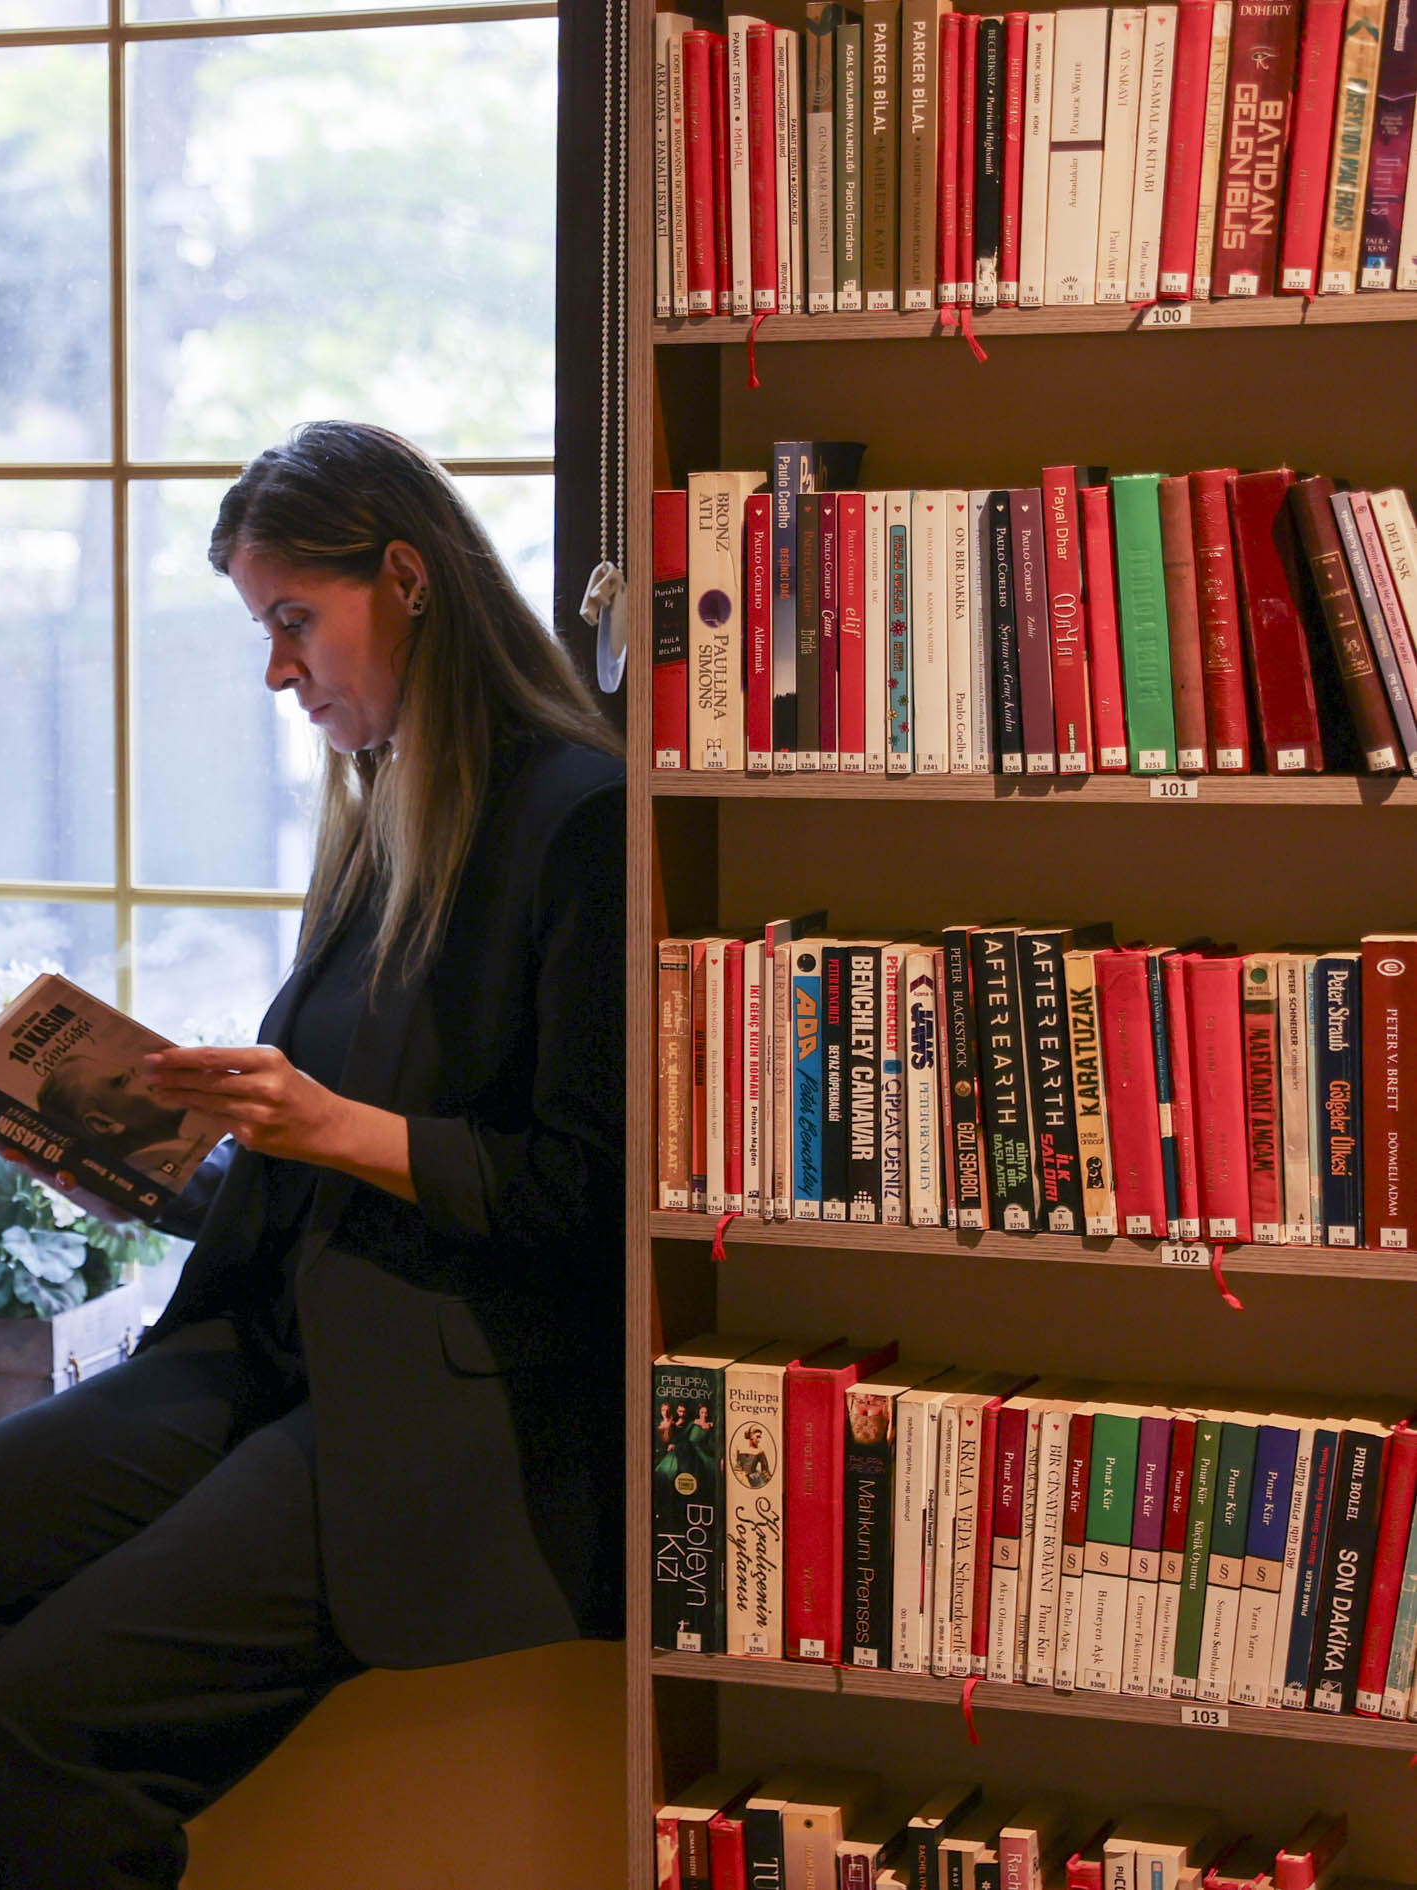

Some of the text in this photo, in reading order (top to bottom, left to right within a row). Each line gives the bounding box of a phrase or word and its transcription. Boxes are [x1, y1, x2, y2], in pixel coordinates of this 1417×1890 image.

[1240, 5, 1291, 16] DOHERTY
[732, 32, 741, 68] PANAIT
[873, 23, 889, 136] PARKER BİLAL
[912, 20, 928, 134] PARKER BİLAL
[656, 62, 666, 121] ARKADAŞ
[733, 72, 742, 110] ISTRATI
[845, 44, 856, 173] ASAL SAYILARIN YALNIZLIĞI
[983, 96, 995, 175] Patricia Highsmith
[1229, 83, 1283, 235] BATIDAN GELEN
[844, 181, 855, 261] Paolo Giordano
[1153, 309, 1182, 324] 100
[698, 492, 730, 553] BRONZ ATLI
[777, 455, 791, 529] Paulo Coelho
[1051, 486, 1071, 561] Payal Dhar
[754, 531, 765, 674] PAULO COELHO Aldatmak
[821, 532, 835, 637] PAULO COELHO Casus
[1021, 529, 1034, 603] PAULO COELHO
[1394, 556, 1411, 581] AŞK
[841, 607, 861, 638] elif
[954, 527, 967, 720] ON BİR DAKİKA Paulo
[996, 527, 1016, 733] PAULO COELHO Şeytan Genç Kadın
[698, 634, 729, 721] PAULLINA SIMONS
[1159, 782, 1188, 796] 101
[950, 947, 962, 983] PETER
[8, 1042, 37, 1065] 10
[23, 1003, 77, 1048] KASIM
[828, 958, 841, 1122] PETER BENCHLEY BEYAZ KÖPEKBALIĞI
[952, 990, 966, 1068] BLACKSTOCK
[984, 938, 1017, 1124] AFTER EARTH
[1032, 940, 1065, 1126] AFTER EARTH
[1288, 969, 1299, 1046] PETER SCHNEIDER
[747, 1002, 760, 1167] GENÇ KIZIN ROMANI Perihan Mağden
[851, 955, 874, 1160] BENCHLEY CANAVAR
[880, 955, 903, 1199] PETER BENCHLEY ÇIPLAK DENİZ
[1069, 986, 1101, 1117] KARATUZAK
[1325, 970, 1356, 1176] Peter Straub Gölgeler Ülkesi
[795, 986, 820, 1199] ADA Peter Benchley
[910, 1002, 934, 1193] JAWS PETER BENCHLEY
[1386, 1008, 1400, 1216] PETER V. BRETT DÖVMELİ ADAM
[43, 1148, 66, 1163] 10
[667, 1136, 679, 1174] SAAT
[958, 1153, 978, 1201] SEMBOL
[1040, 1132, 1059, 1202] SALDIRI
[1055, 1153, 1074, 1182] İLK
[1252, 1119, 1274, 1172] AMCAM
[1172, 1249, 1200, 1264] 102
[656, 1375, 712, 1401] PHILIPPA GREGORY
[729, 1388, 779, 1416] Philippa Gregory
[956, 1439, 976, 1551] KRALA VEDA
[1070, 1459, 1083, 1513] Pınar Kür
[1142, 1462, 1157, 1517] Pınar Kür
[1172, 1470, 1184, 1513] Pınar Kür
[1224, 1468, 1240, 1526] Pınar Kür
[1262, 1503, 1276, 1526] Kür
[1265, 1470, 1278, 1502] Pınar
[1345, 1446, 1367, 1521] PIRIL BOLEL
[679, 1503, 714, 1607] Boleyn
[726, 1506, 757, 1612] Soytarısı
[750, 1496, 780, 1629] Kraliçenin
[855, 1479, 877, 1643] Mahkum Prenses
[995, 1451, 1015, 1645] Pınar Kür Olmayan
[1037, 1444, 1062, 1635] BİR CİNAYET ROMANI Pınar
[1092, 1456, 1116, 1665] Pınar Kür Aşk
[1188, 1458, 1211, 1590] Pınar Kür Küçük Oyuncu
[1300, 1570, 1313, 1617] PINAR SELEK
[1323, 1548, 1359, 1671] SON DAKİKA
[1191, 1710, 1220, 1725] 103
